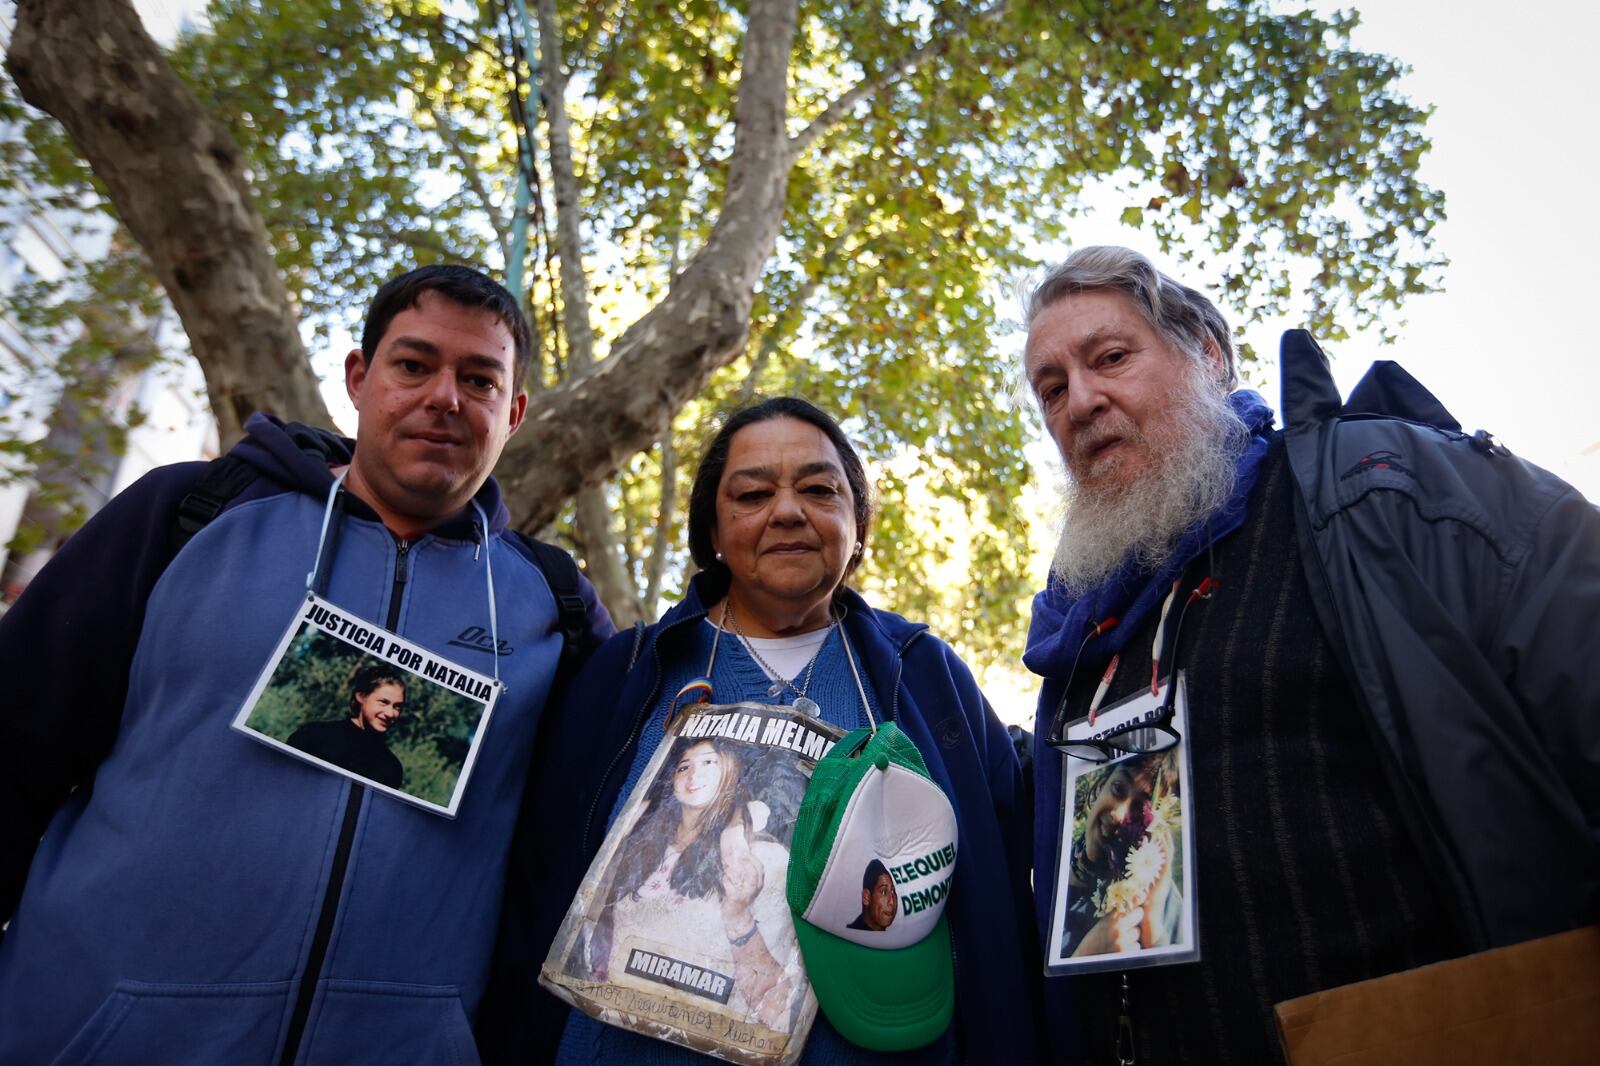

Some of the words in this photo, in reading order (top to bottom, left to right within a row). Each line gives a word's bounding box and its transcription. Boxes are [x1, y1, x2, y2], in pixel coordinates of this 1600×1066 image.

[304, 603, 384, 658] JUSTICIA
[385, 641, 423, 671] POR
[423, 659, 493, 702] NATALIA
[679, 712, 762, 743] NATALIA
[889, 842, 956, 885] EZEQUIEL
[629, 951, 728, 997] MIRAMAR
